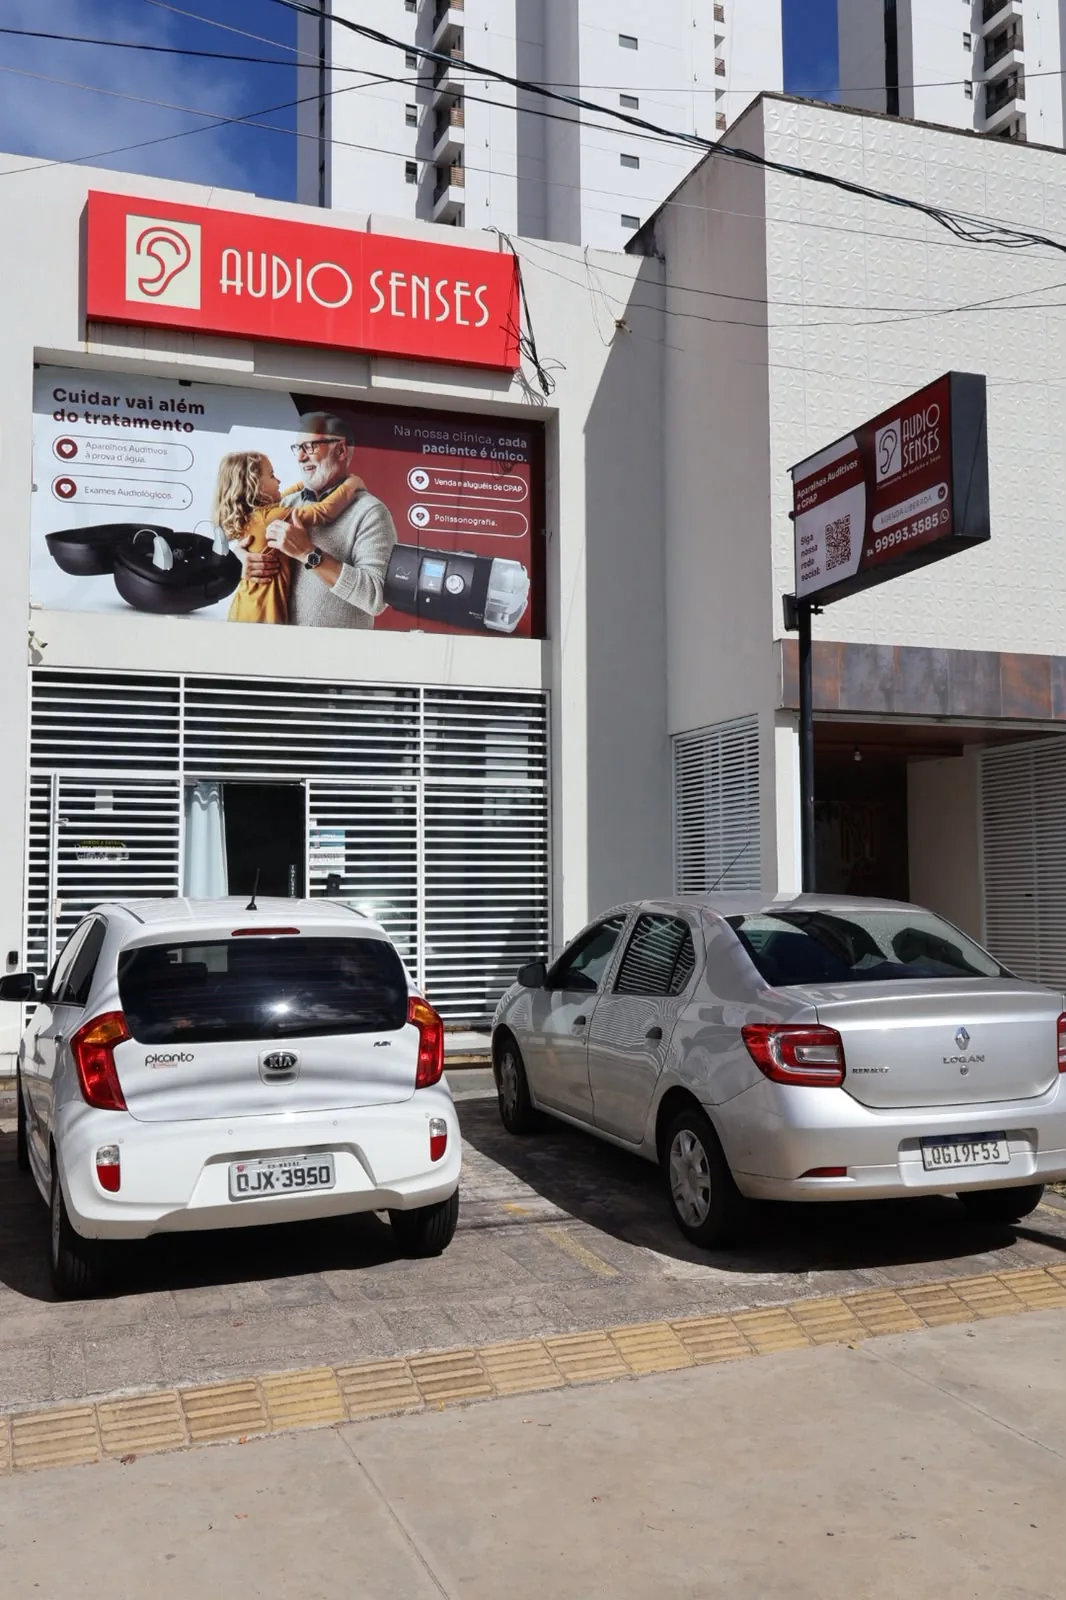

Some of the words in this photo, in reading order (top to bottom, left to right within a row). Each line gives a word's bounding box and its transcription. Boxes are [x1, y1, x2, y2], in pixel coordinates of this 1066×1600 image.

[219, 247, 353, 309] AUDIO
[369, 270, 490, 328] SENSES
[53, 387, 120, 407] Cuidar
[125, 396, 153, 410] vai
[159, 397, 205, 415] além
[53, 408, 78, 423] do
[84, 411, 194, 433] tratamento
[902, 403, 940, 443] AUDIO
[394, 425, 411, 437] Na
[414, 428, 449, 440] nossa
[452, 431, 495, 446] clínica,
[498, 437, 527, 449] cada
[85, 441, 127, 453] Aparelhos
[129, 445, 168, 456] Auditivos
[422, 444, 477, 457] paciente
[480, 447, 487, 458] é
[490, 448, 527, 462] único.
[903, 427, 940, 468] SENSES
[91, 452, 115, 462] prova
[827, 460, 858, 484] Auditivos
[84, 486, 117, 496] Exames
[434, 478, 457, 487] Venda
[463, 480, 492, 491] aluguéis
[493, 483, 502, 492] de
[801, 493, 818, 509] CPAP
[800, 534, 814, 546] Siga
[874, 512, 939, 553] 99993.3585
[800, 544, 818, 557] nossa
[144, 1051, 195, 1067] picanto
[269, 1056, 292, 1068] KIA
[942, 1054, 985, 1065] LOGAN
[931, 1141, 1001, 1165] QGI9F53
